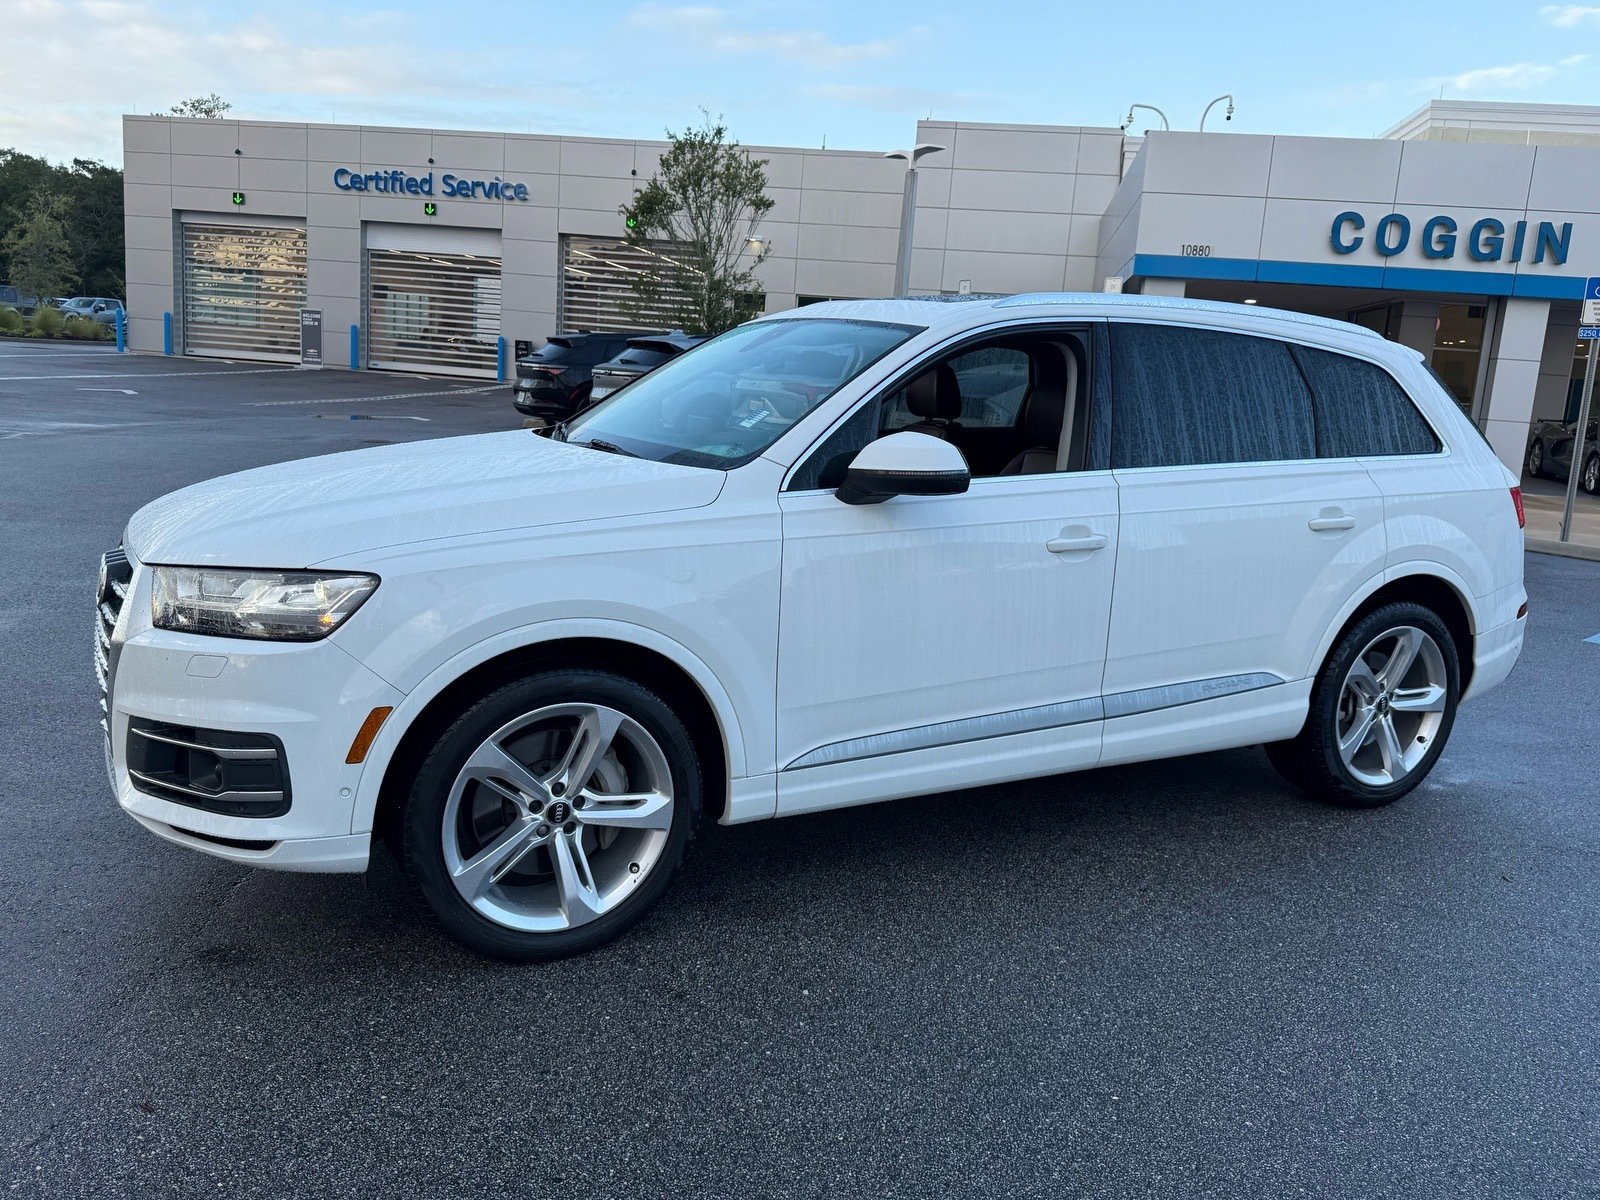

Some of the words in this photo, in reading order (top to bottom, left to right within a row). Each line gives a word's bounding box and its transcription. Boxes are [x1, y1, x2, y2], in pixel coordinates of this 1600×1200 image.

[333, 168, 433, 195] Certified
[442, 174, 529, 200] Service
[1330, 211, 1573, 264] COGGIN
[1181, 244, 1211, 257] 10880
[1579, 329, 1597, 337] $250
